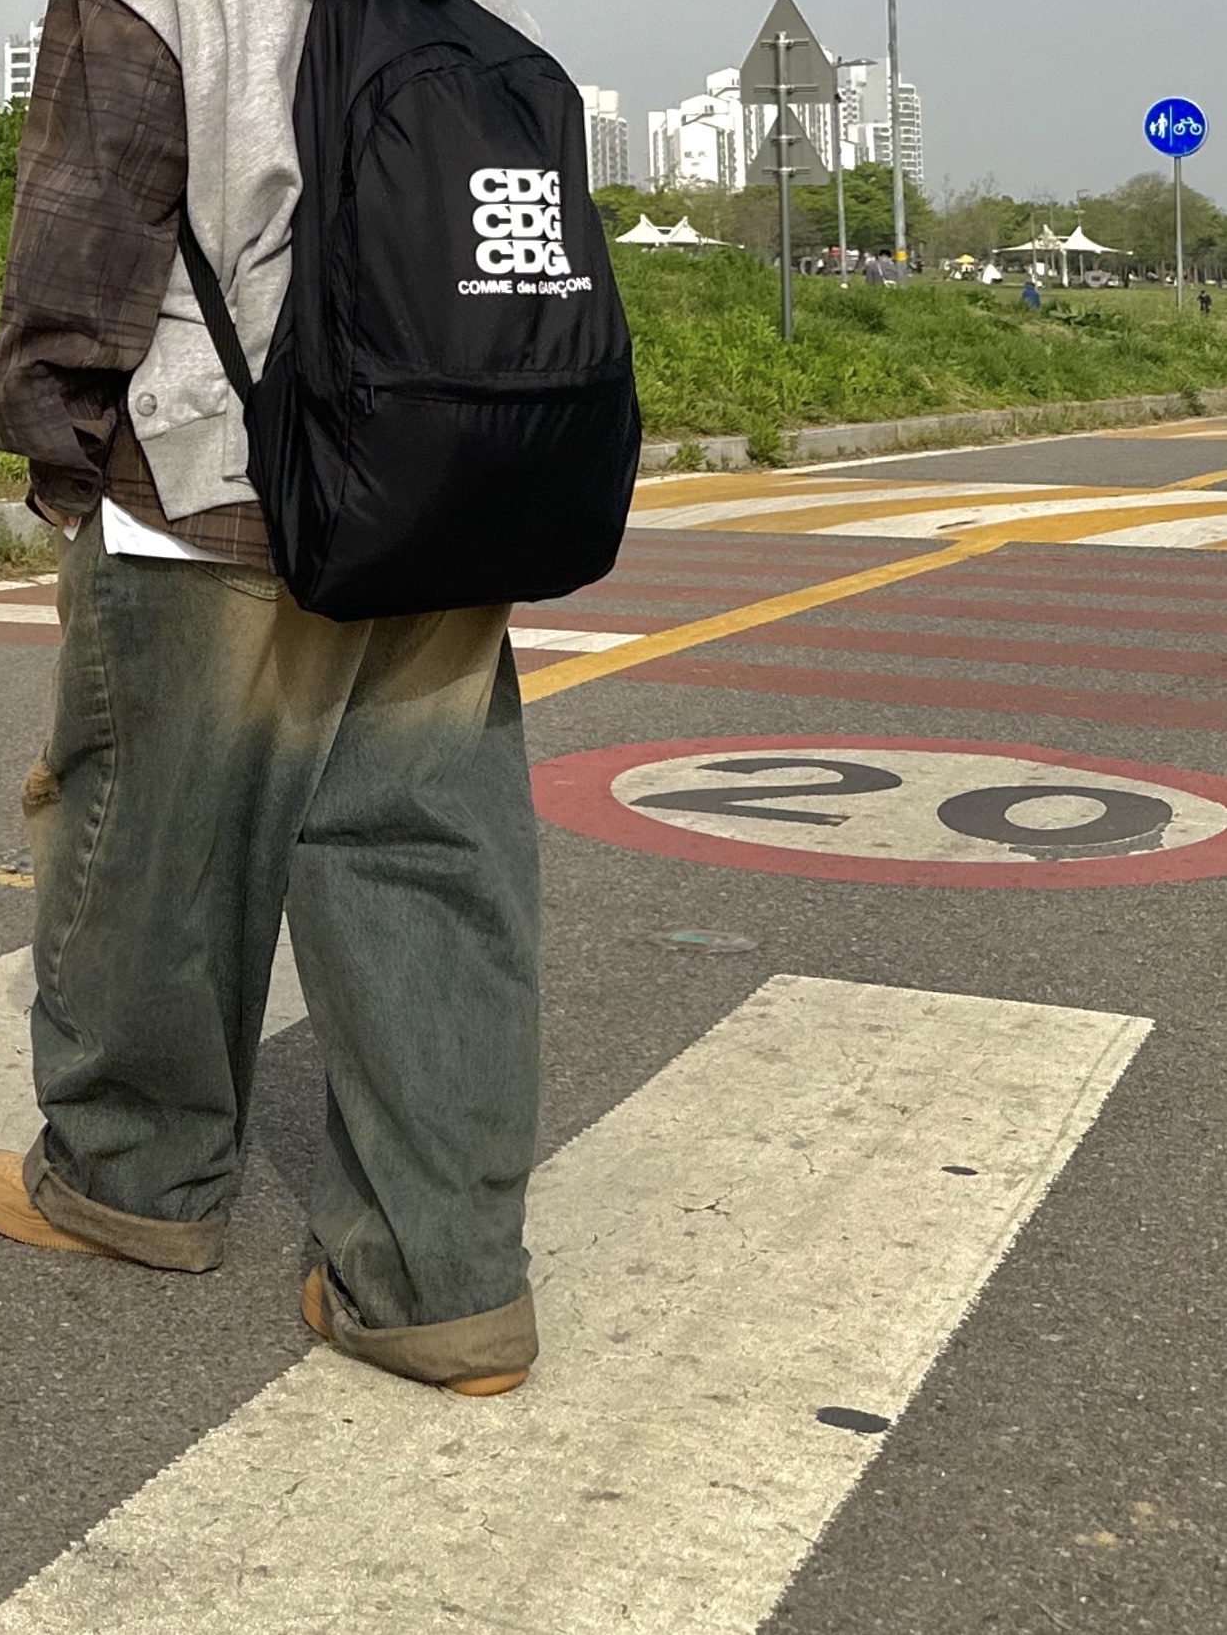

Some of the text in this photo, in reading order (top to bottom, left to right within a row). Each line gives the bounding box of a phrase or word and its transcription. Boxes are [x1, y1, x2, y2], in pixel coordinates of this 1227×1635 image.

[469, 168, 561, 205] CDG
[472, 204, 563, 241] CDG
[476, 239, 571, 277] CDG
[458, 280, 513, 295] COMME
[516, 280, 537, 294] des
[629, 756, 1174, 851] 20
